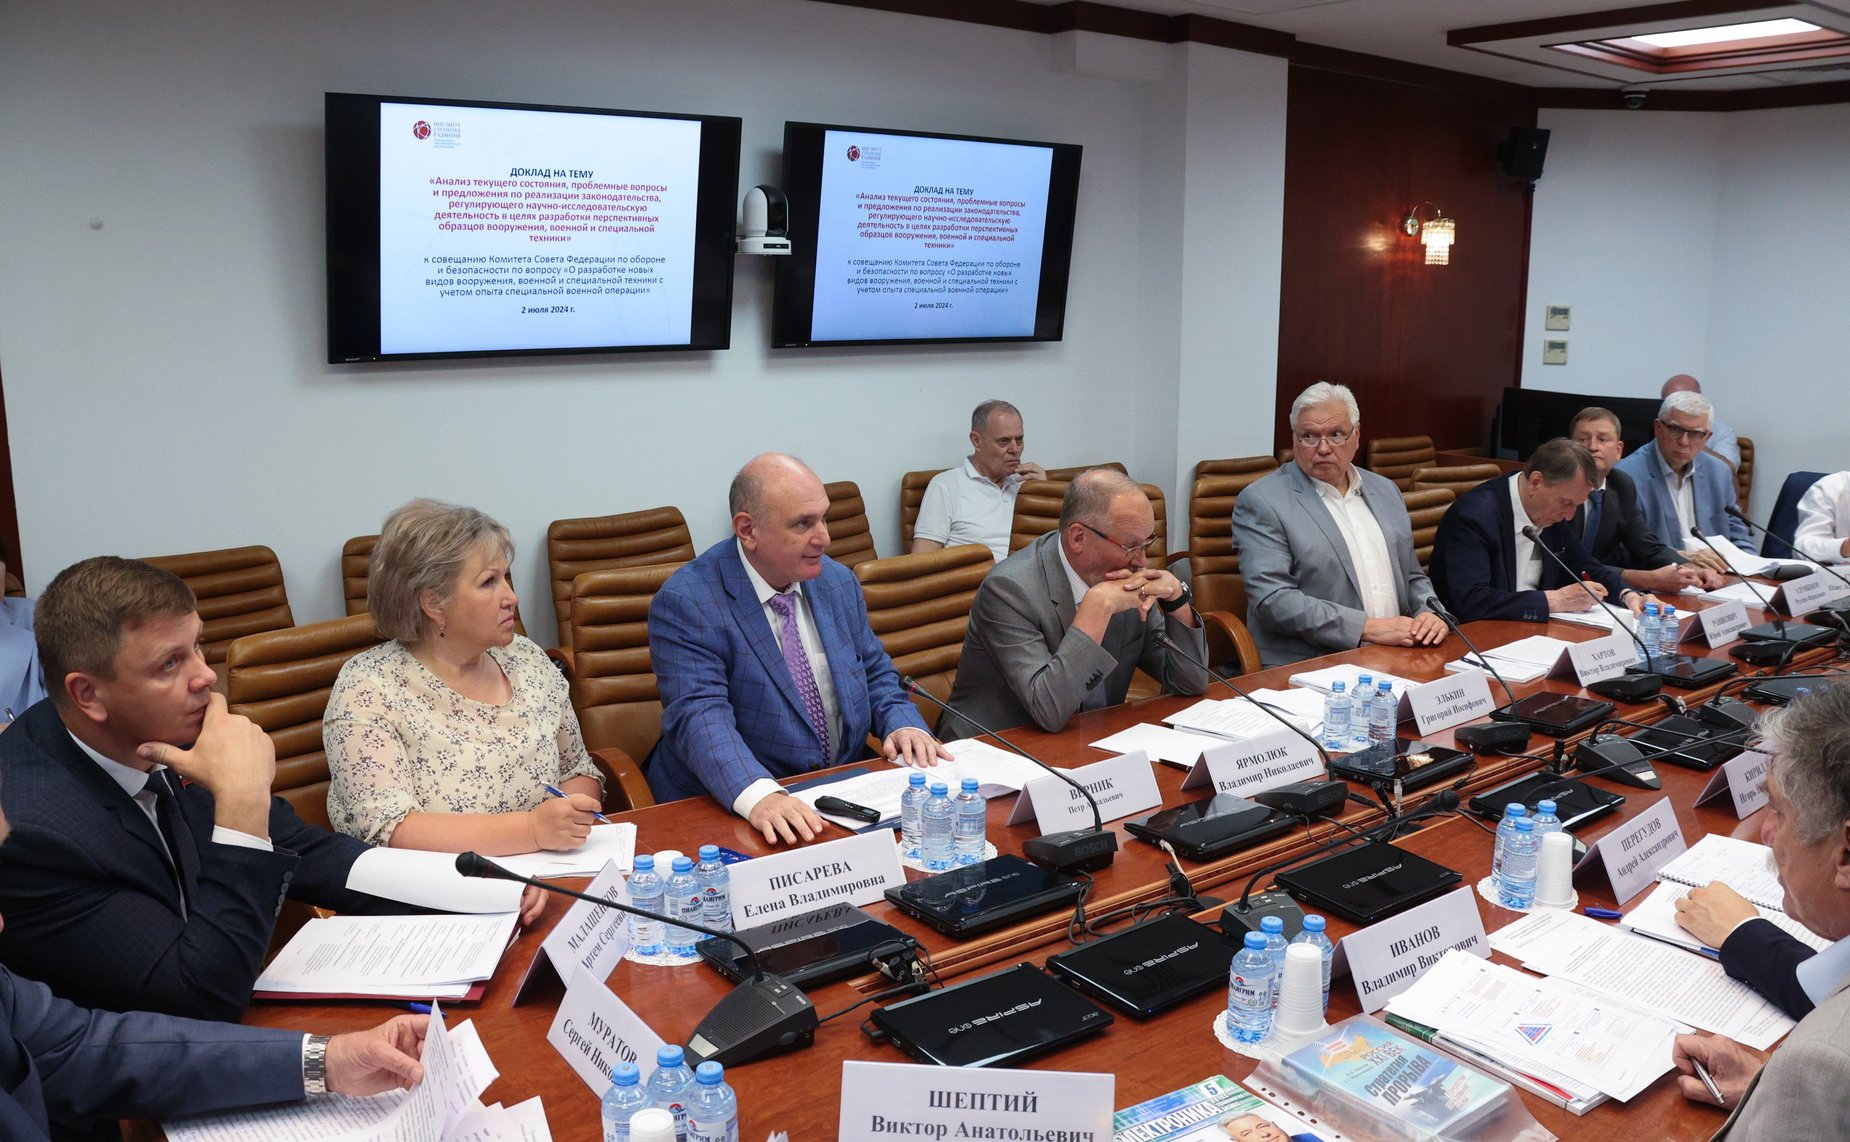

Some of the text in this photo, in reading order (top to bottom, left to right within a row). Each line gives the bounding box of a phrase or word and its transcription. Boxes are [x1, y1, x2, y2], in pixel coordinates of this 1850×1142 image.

[429, 177, 667, 193] «Анализ текущего состояния, проблемные вопросы
[509, 168, 551, 179] ДОКЛАД
[568, 170, 594, 179] ТЕМУ
[442, 190, 508, 200] предложения
[524, 192, 579, 201] реализации
[581, 194, 662, 203] законодательства,
[448, 201, 648, 214] регулирующего научно-исследовательскую
[434, 212, 500, 221] деятельность
[538, 212, 591, 223] разработки
[593, 215, 659, 223] перспективных
[438, 221, 484, 232] образцов
[487, 224, 547, 233] вооружения,
[598, 226, 655, 234] специальной
[446, 266, 510, 274] безопасности
[525, 267, 562, 275] вопросу
[578, 265, 626, 275] разработке
[534, 255, 565, 263] Совета
[566, 255, 615, 264] Федерации
[630, 255, 666, 265] обороне
[425, 279, 454, 287] видов
[566, 276, 623, 285] специальной
[439, 290, 473, 298] учетом
[505, 287, 564, 296] специальной
[604, 288, 651, 296] операции»
[1592, 649, 1616, 661] ХАРТОВ
[1435, 688, 1466, 705] ЭЛЬКИН
[1421, 697, 1487, 725] Григорий Иосифович
[1236, 746, 1288, 770] ЯРМОЛЮК
[1219, 757, 1315, 792] Владимир Николаевич
[1068, 793, 1124, 814] Петр Акадьевич
[1621, 817, 1662, 852] ПЕРЕГУДОВ
[1617, 854, 1639, 878] Андрей
[1638, 830, 1679, 863] Александрович
[769, 861, 852, 891] ПИСАРЕВА
[744, 892, 786, 918] Елена
[789, 875, 886, 908] Владимировна
[567, 885, 619, 953] МАЛАЩЕНОВ
[1390, 925, 1441, 958] ИВАНОВ
[1142, 941, 1199, 968] ASPIRE
[1362, 963, 1417, 995] Владимир
[971, 998, 1042, 1026] ASPIRE
[563, 1018, 593, 1057] Сергей
[1364, 1054, 1408, 1097] Стратегия
[1381, 1054, 1432, 1106] ПРОРЫВА
[928, 1090, 1038, 1113] ШЕПТИЙ
[1206, 1083, 1217, 1096] 5
[871, 1115, 1095, 1142] Виктор Анатольевич
